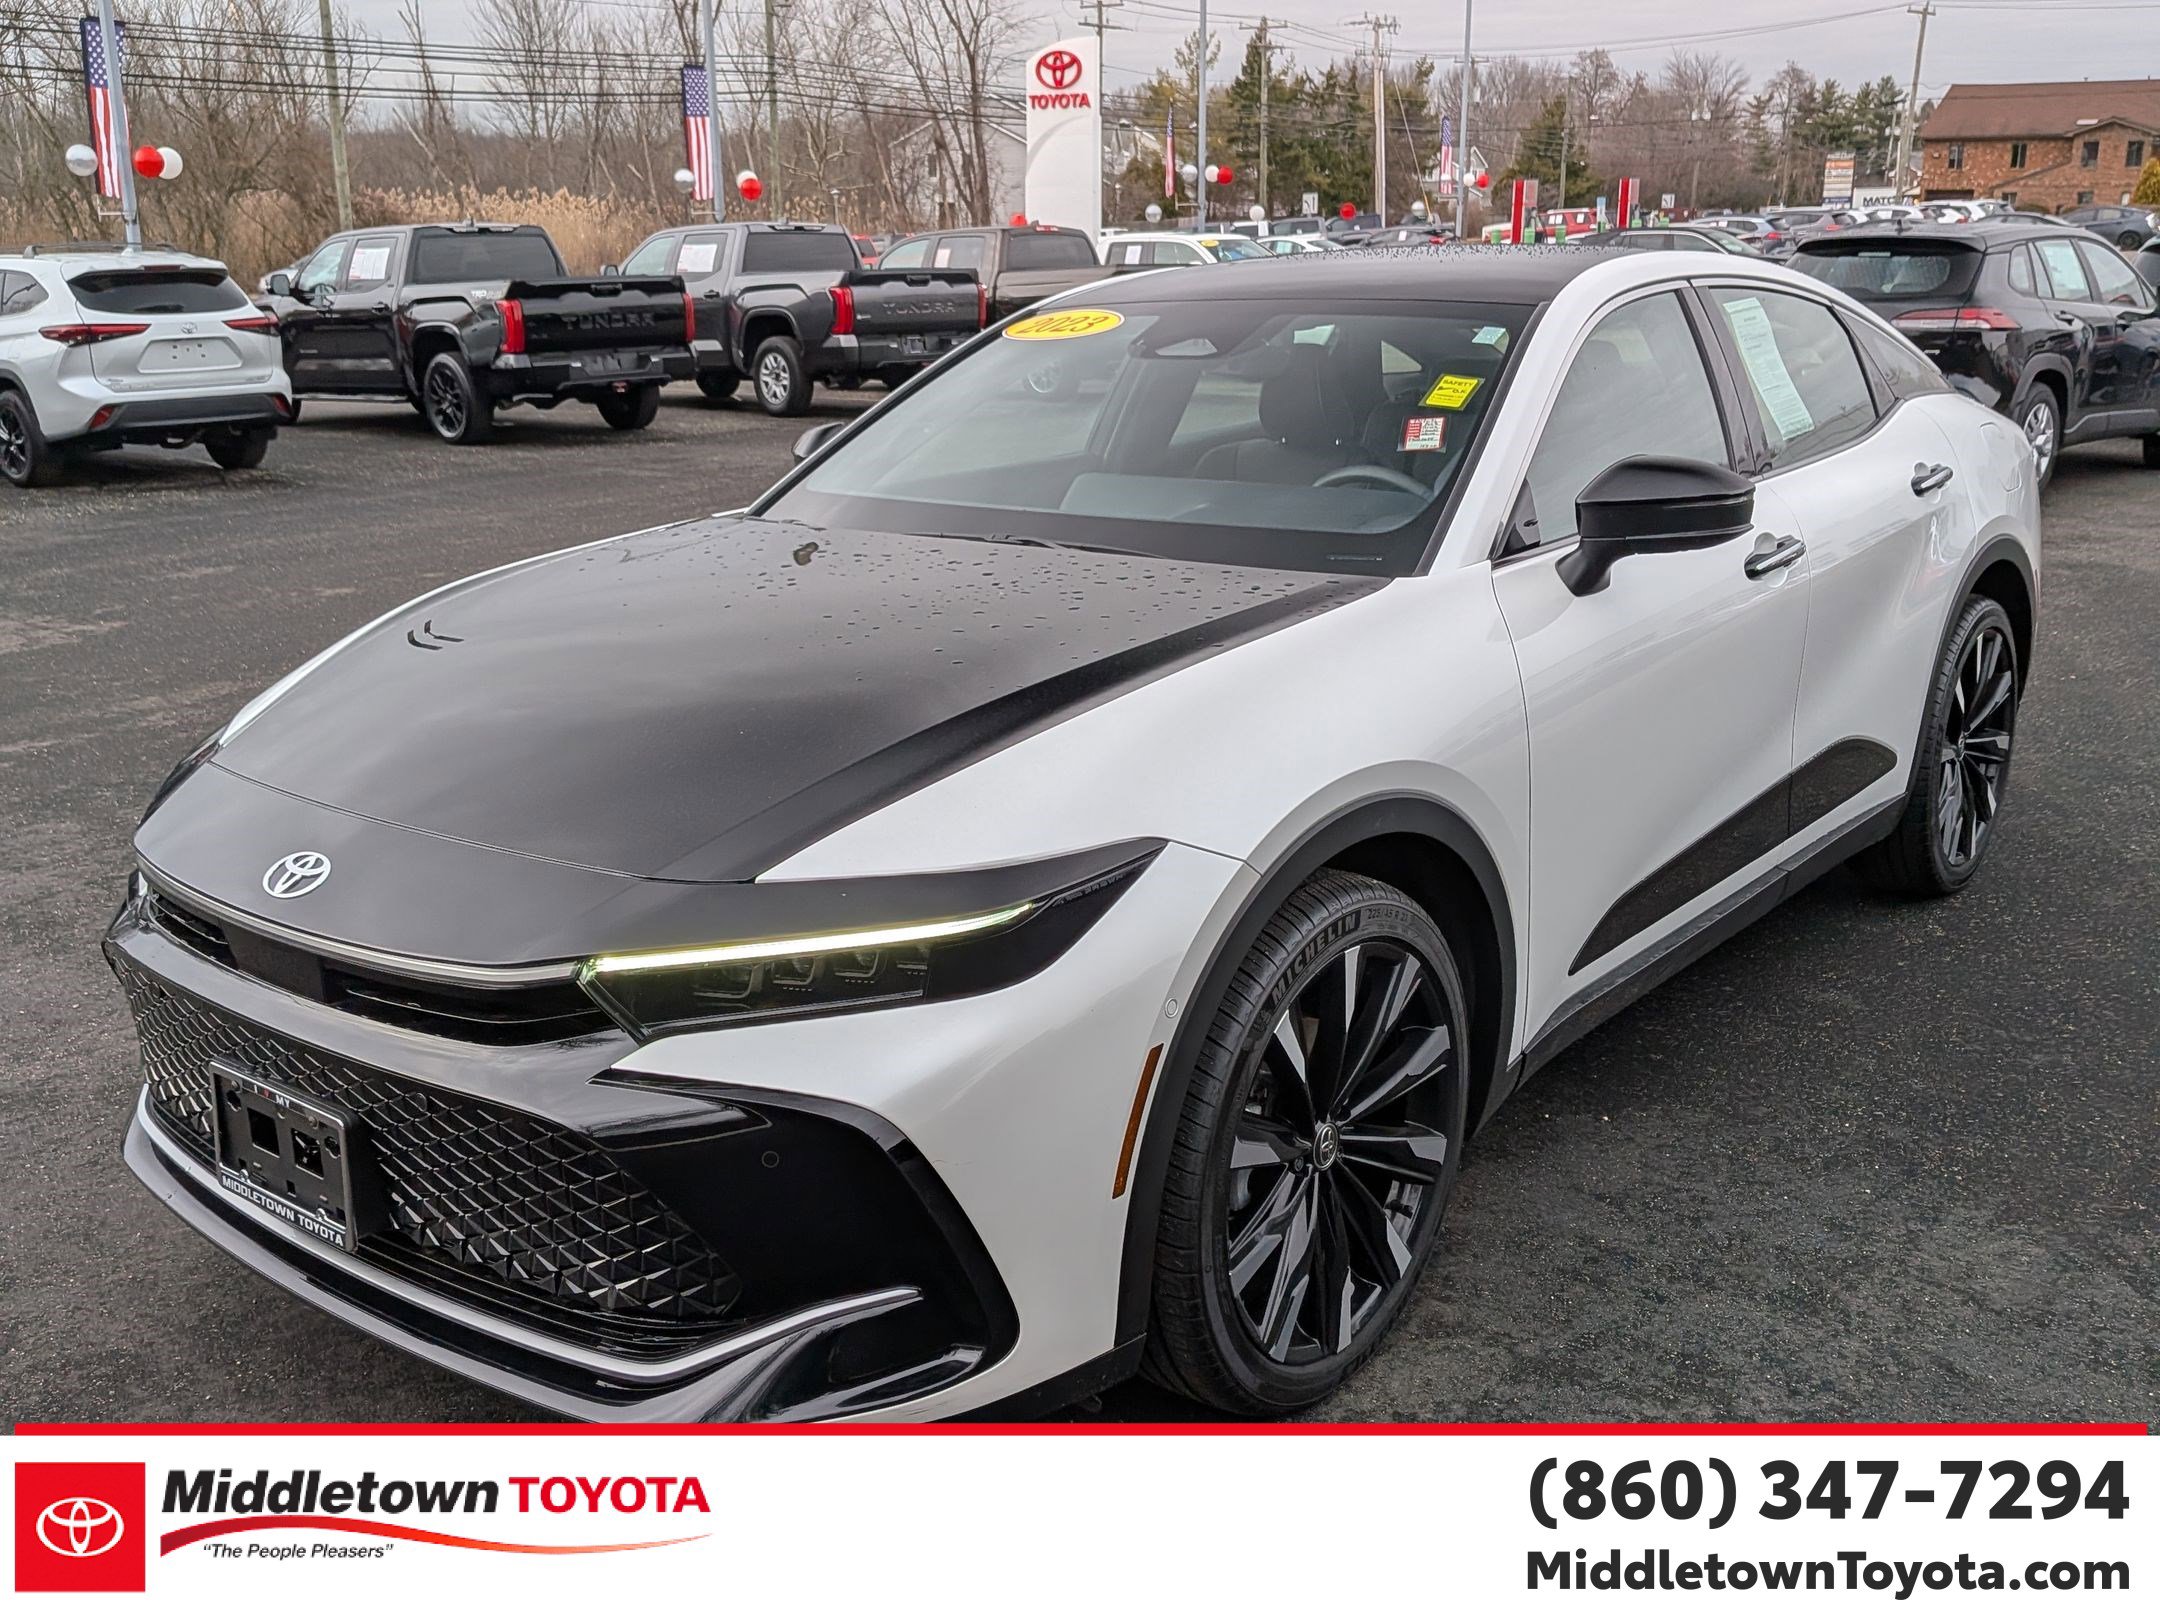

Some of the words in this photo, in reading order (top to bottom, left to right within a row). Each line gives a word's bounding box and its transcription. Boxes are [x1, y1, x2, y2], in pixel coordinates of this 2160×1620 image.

[1029, 93, 1091, 110] TOYOTA
[561, 312, 656, 330] TUNDRA
[1015, 316, 1109, 334] 2023
[1443, 379, 1474, 387] SAFETY
[1272, 912, 1357, 1006] MICHELIN
[275, 1094, 291, 1109] MY
[221, 1175, 296, 1222] MIDDLETOWN
[297, 1213, 345, 1247] TOYOTA
